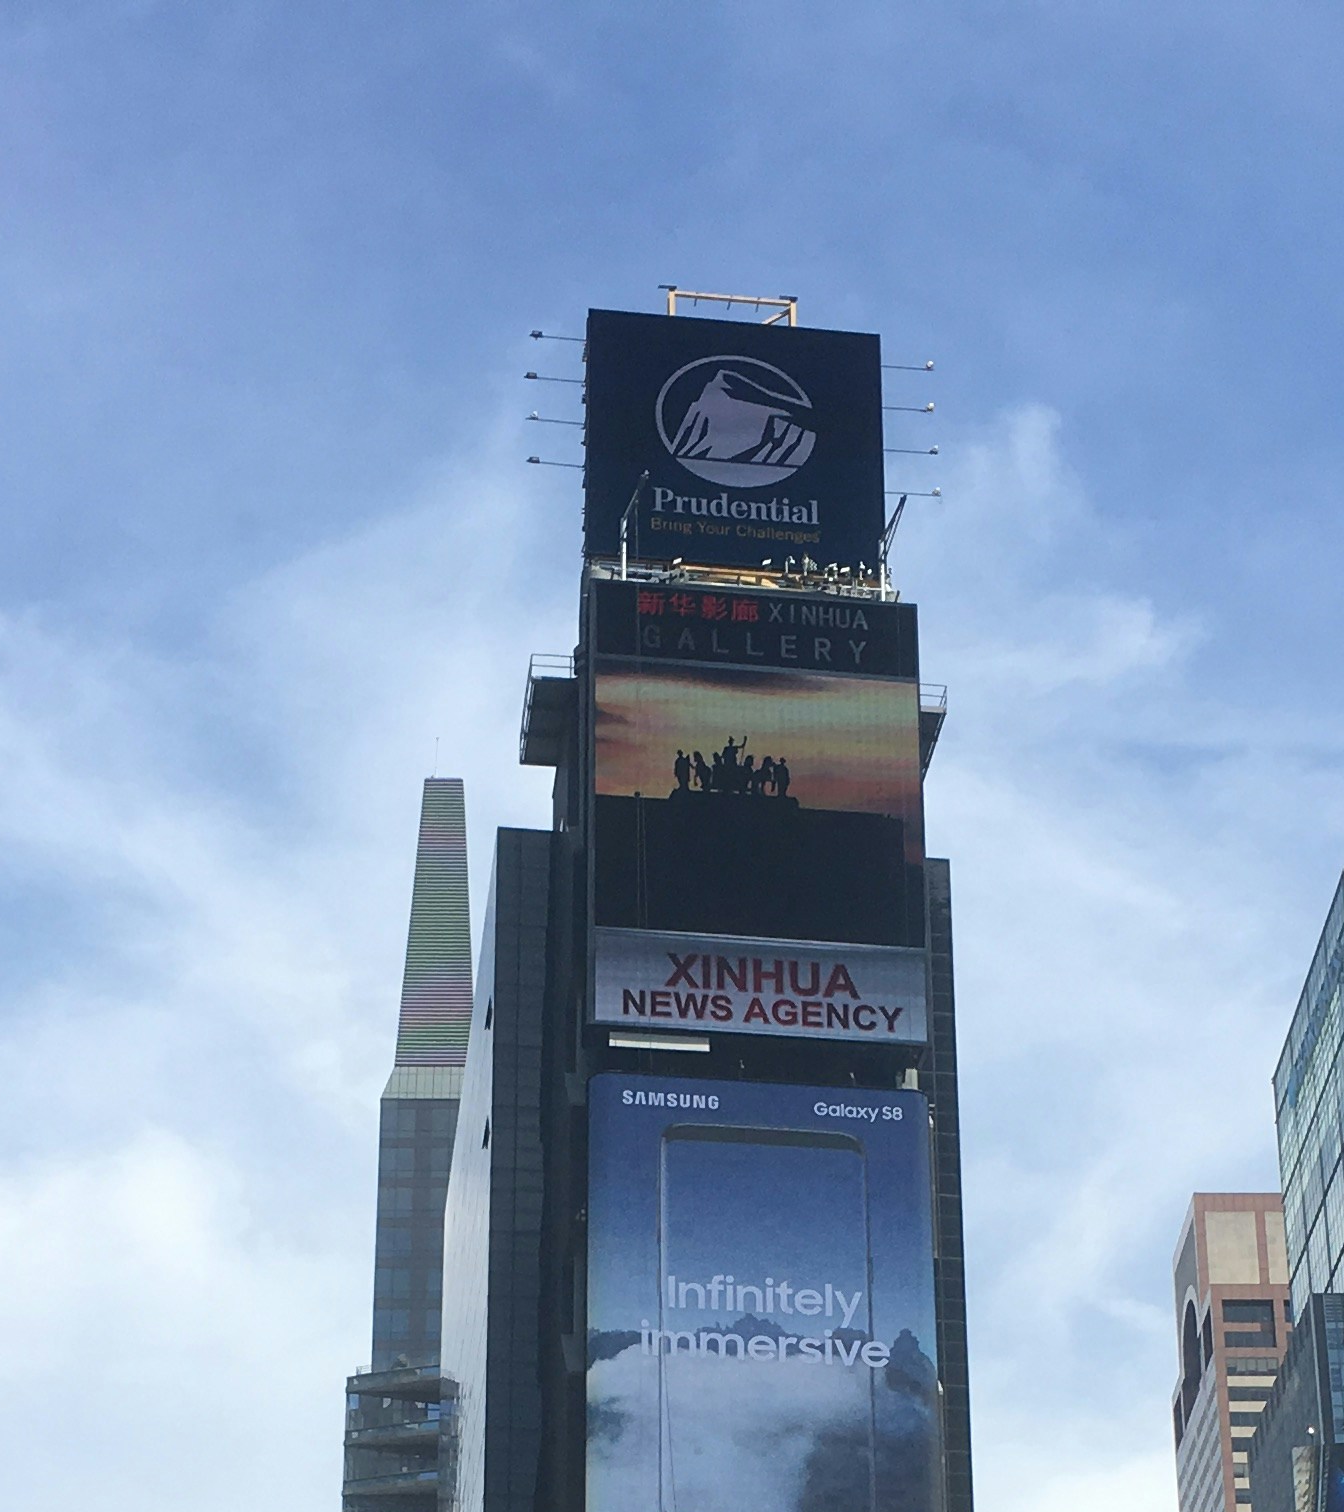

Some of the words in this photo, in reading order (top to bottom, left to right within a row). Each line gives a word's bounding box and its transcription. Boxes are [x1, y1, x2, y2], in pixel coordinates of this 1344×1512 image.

[652, 486, 820, 525] Prudential
[650, 517, 692, 535] Bring
[697, 521, 730, 536] Your
[736, 524, 821, 544] Challenges
[768, 602, 869, 631] XINHUA
[643, 625, 867, 664] GALLERY
[663, 952, 862, 1001] XINHUA
[622, 988, 733, 1022] NEWS
[744, 997, 903, 1033] AGENCY
[622, 1089, 720, 1110] SAMSUNG
[813, 1101, 879, 1123] Galaxy
[882, 1104, 904, 1121] S8
[666, 1274, 863, 1331] Infinitely
[639, 1319, 891, 1368] immersive
